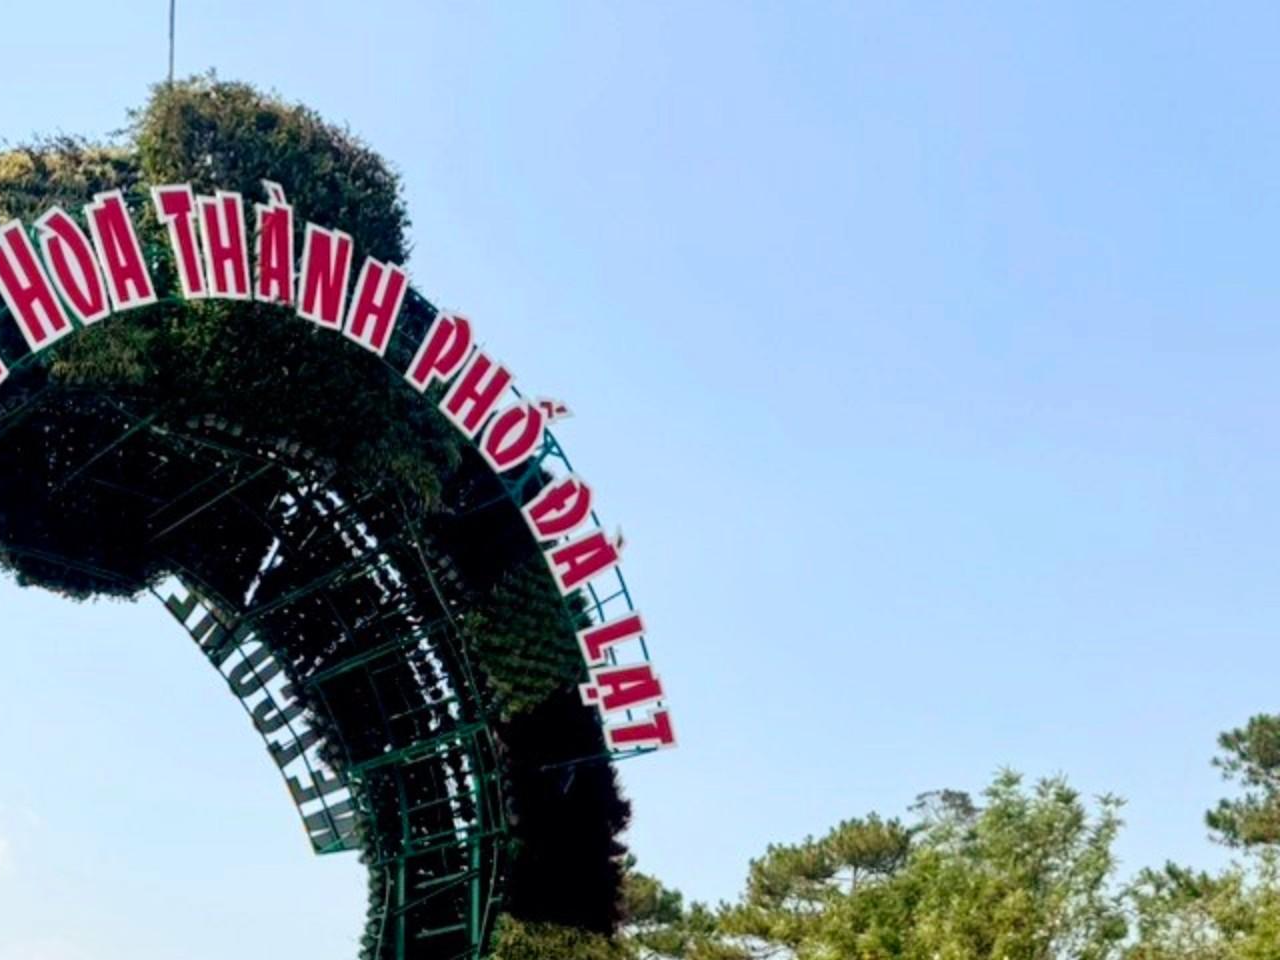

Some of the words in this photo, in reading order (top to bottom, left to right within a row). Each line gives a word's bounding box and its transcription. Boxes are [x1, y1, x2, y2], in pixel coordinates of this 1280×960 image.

[151, 179, 408, 357] THÀNH
[404, 310, 575, 473] PHỐ
[521, 472, 628, 597] ĐÀ
[576, 611, 678, 751] LẠT
